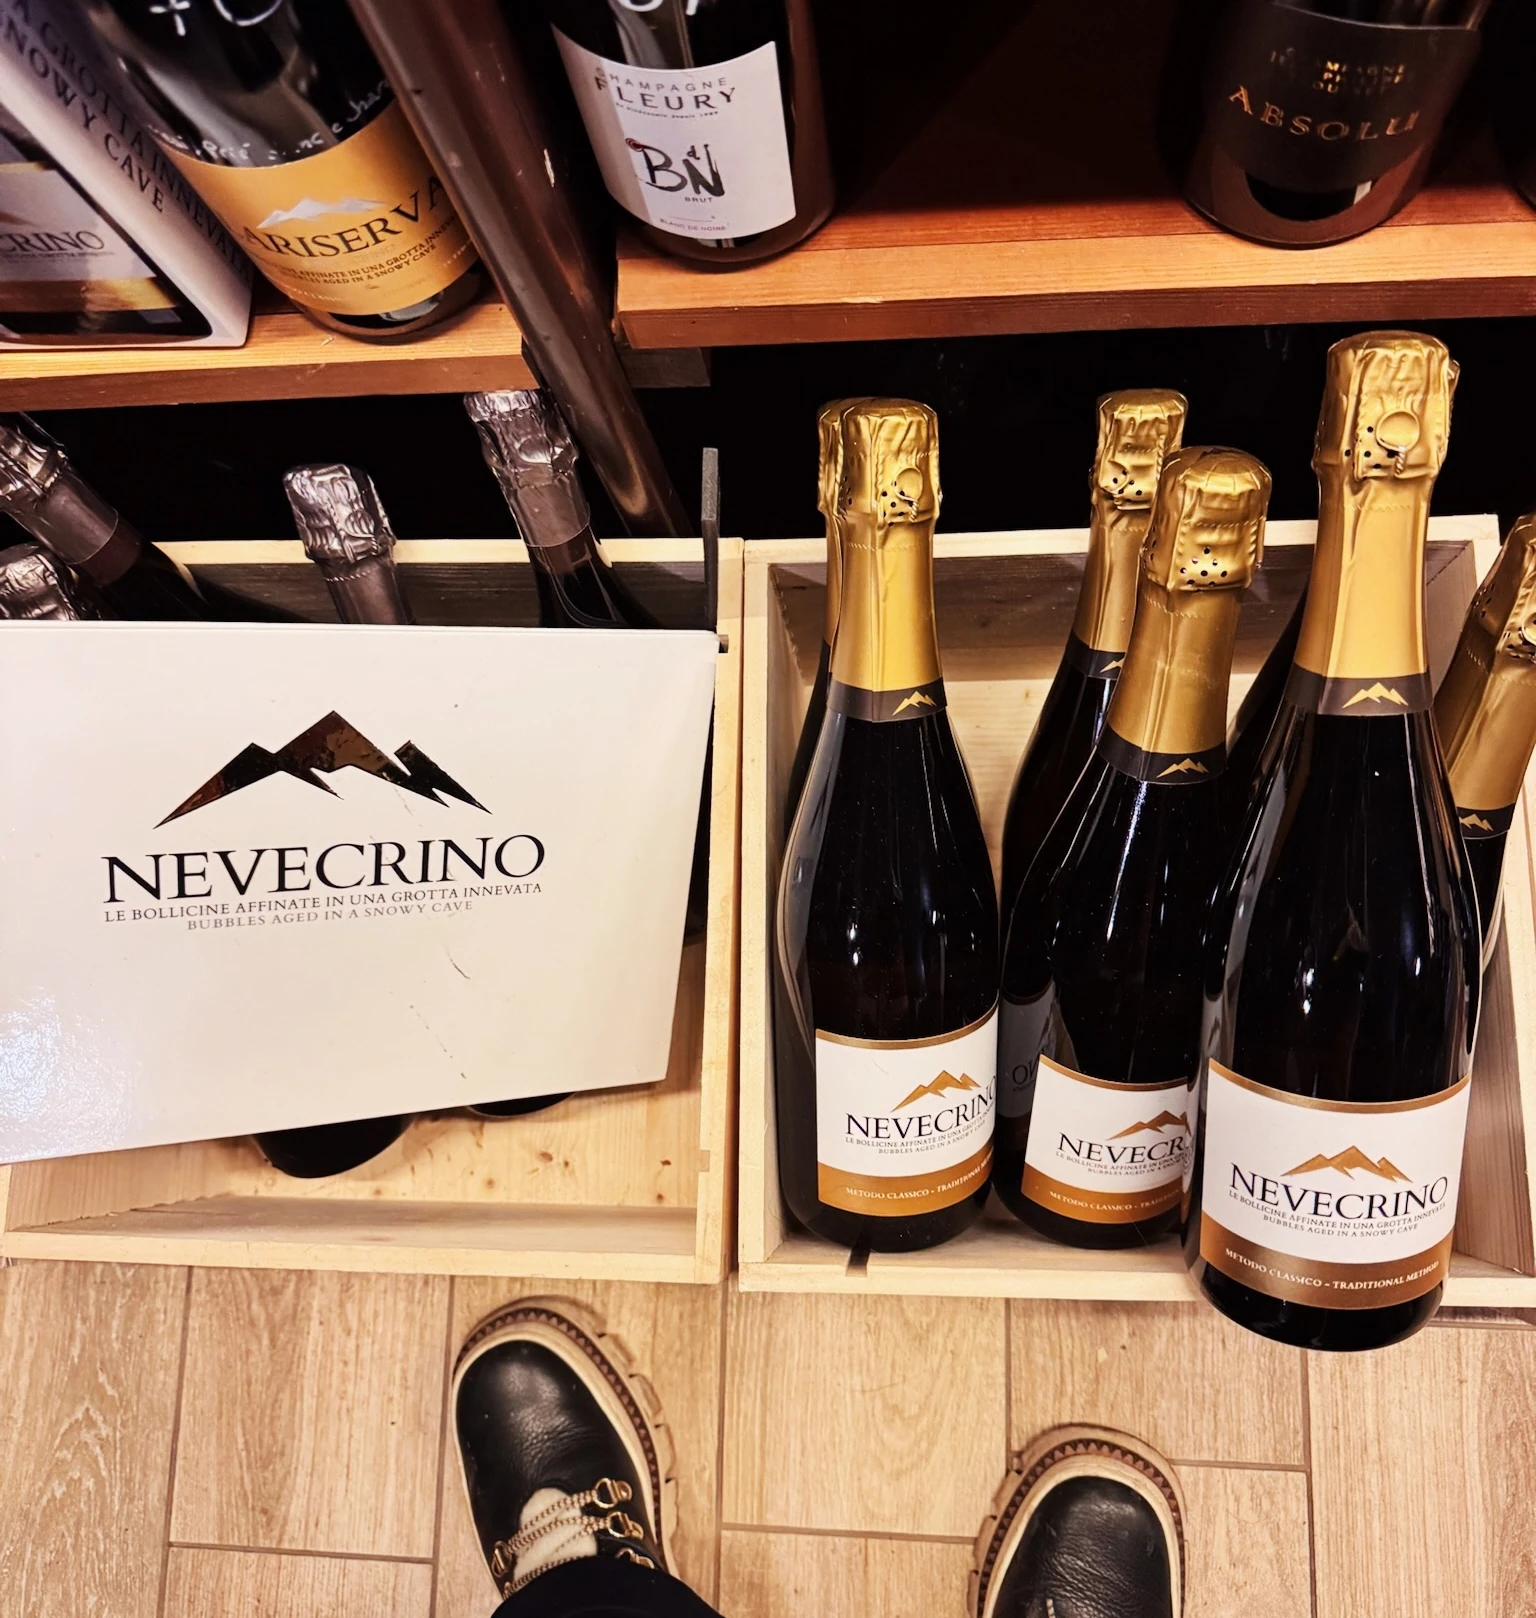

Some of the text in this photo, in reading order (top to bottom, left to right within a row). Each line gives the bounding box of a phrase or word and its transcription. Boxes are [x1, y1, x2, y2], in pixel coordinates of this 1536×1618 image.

[594, 76, 735, 110] FLEURY
[0, 12, 165, 213] NOWY CAVE
[1228, 84, 1420, 141] ABSOLU
[349, 268, 361, 277] IN
[361, 263, 385, 275] UNA
[386, 242, 425, 266] GROTTA
[375, 259, 411, 278] SNOWY
[412, 243, 437, 262] CAVE
[101, 834, 546, 904] NEVECRINO
[104, 883, 542, 923] LE BOLLICINE AFFINATE IN UNA GROTTA INNEVATA
[187, 900, 473, 931] BUBBLES AGED IN A SNOWY CAVE
[845, 1137, 855, 1145] LE
[856, 1138, 899, 1148] BOLLICINE
[900, 1136, 937, 1148] AFFINATE
[937, 1133, 947, 1142] IN
[947, 1129, 962, 1139] UNA
[915, 1144, 936, 1153] AGED
[1055, 1150, 1065, 1160] LE
[1066, 1155, 1109, 1170] BOLLICINE
[1109, 1163, 1148, 1171] AFFINATE
[845, 1186, 886, 1200] METODO
[886, 1188, 930, 1200] CLASSICO
[1049, 1190, 1088, 1208] METODO
[1229, 1162, 1448, 1220] NEVECRINO
[1229, 1189, 1239, 1200] LE
[1239, 1197, 1287, 1219] BOLLICINE
[1289, 1214, 1338, 1229] AFFINATE
[1339, 1221, 1351, 1229] IN
[1353, 1222, 1374, 1230] UNA
[1376, 1217, 1413, 1229] GROTTA
[1262, 1214, 1419, 1238] BUBBLES AGED IN A SNOWY CAVE
[1225, 1247, 1267, 1273] METODO
[1268, 1267, 1322, 1288] CLASSICO
[1332, 1276, 1405, 1291] TRADITIONAL
[1405, 1260, 1440, 1283] METHOD
